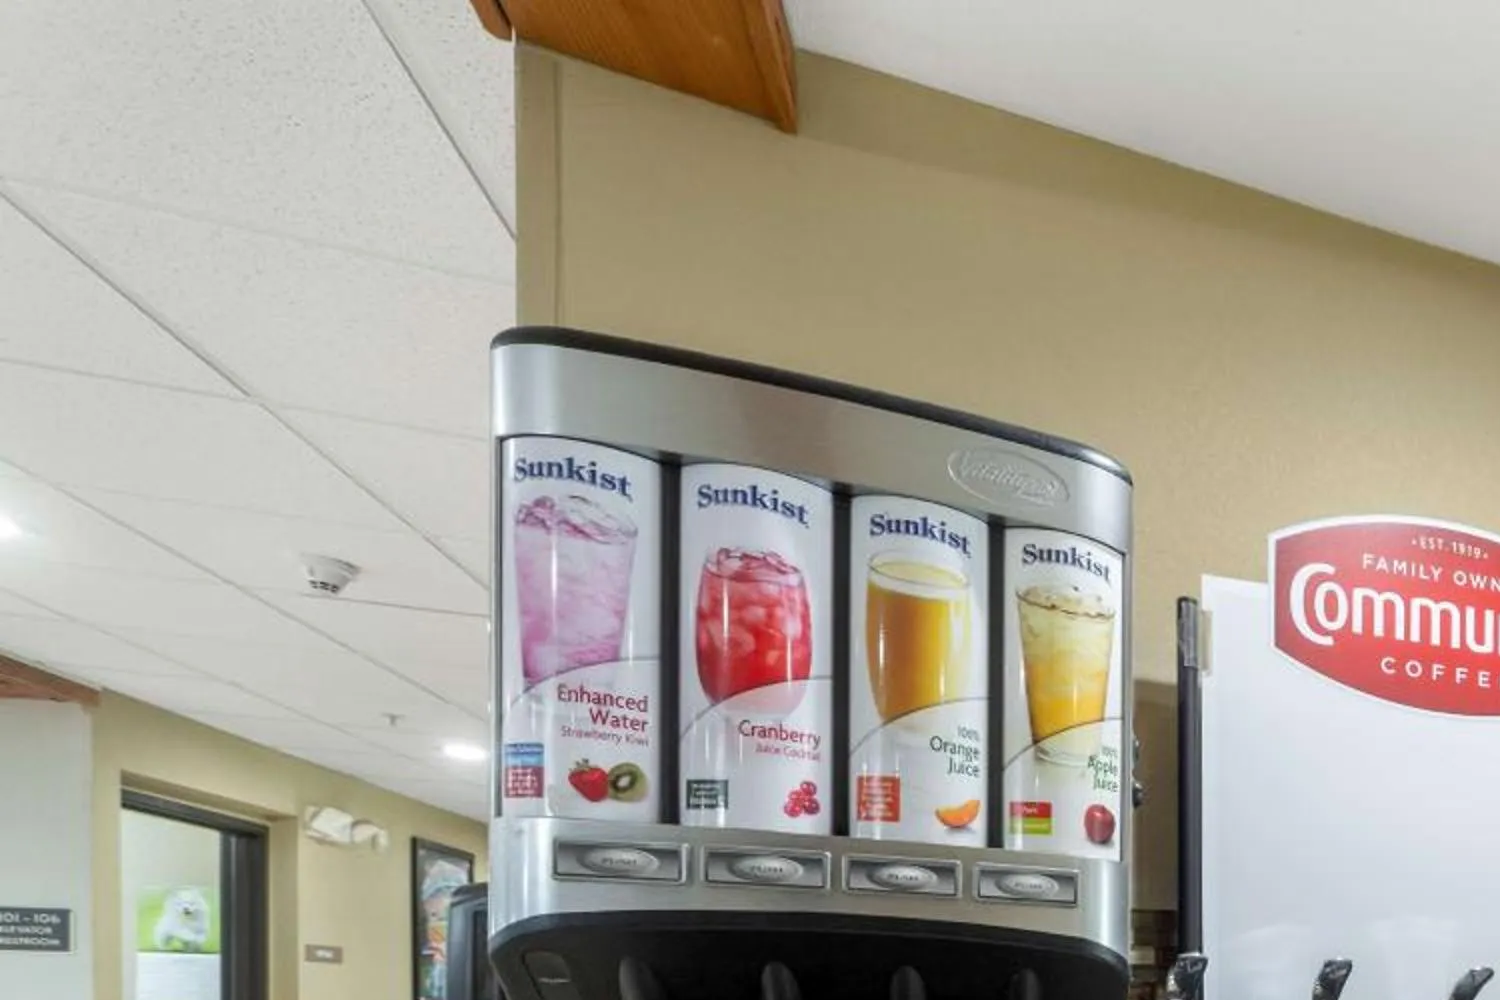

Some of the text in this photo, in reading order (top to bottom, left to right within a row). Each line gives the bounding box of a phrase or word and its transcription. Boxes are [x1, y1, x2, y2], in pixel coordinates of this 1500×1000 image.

[514, 457, 632, 497] Sunkist
[696, 484, 808, 525] Sunkist
[869, 513, 970, 554] Sunkist
[1022, 543, 1111, 585] Sunkist
[1362, 553, 1443, 582] FAMILY
[557, 683, 649, 712] Enhanced
[589, 708, 649, 732] Water
[738, 719, 821, 750] Cranberry
[561, 725, 623, 745] Strawberry
[930, 735, 980, 760] Orange
[947, 756, 980, 777] Juice
[1087, 754, 1118, 777] Apple
[1093, 777, 1118, 793] Juice
